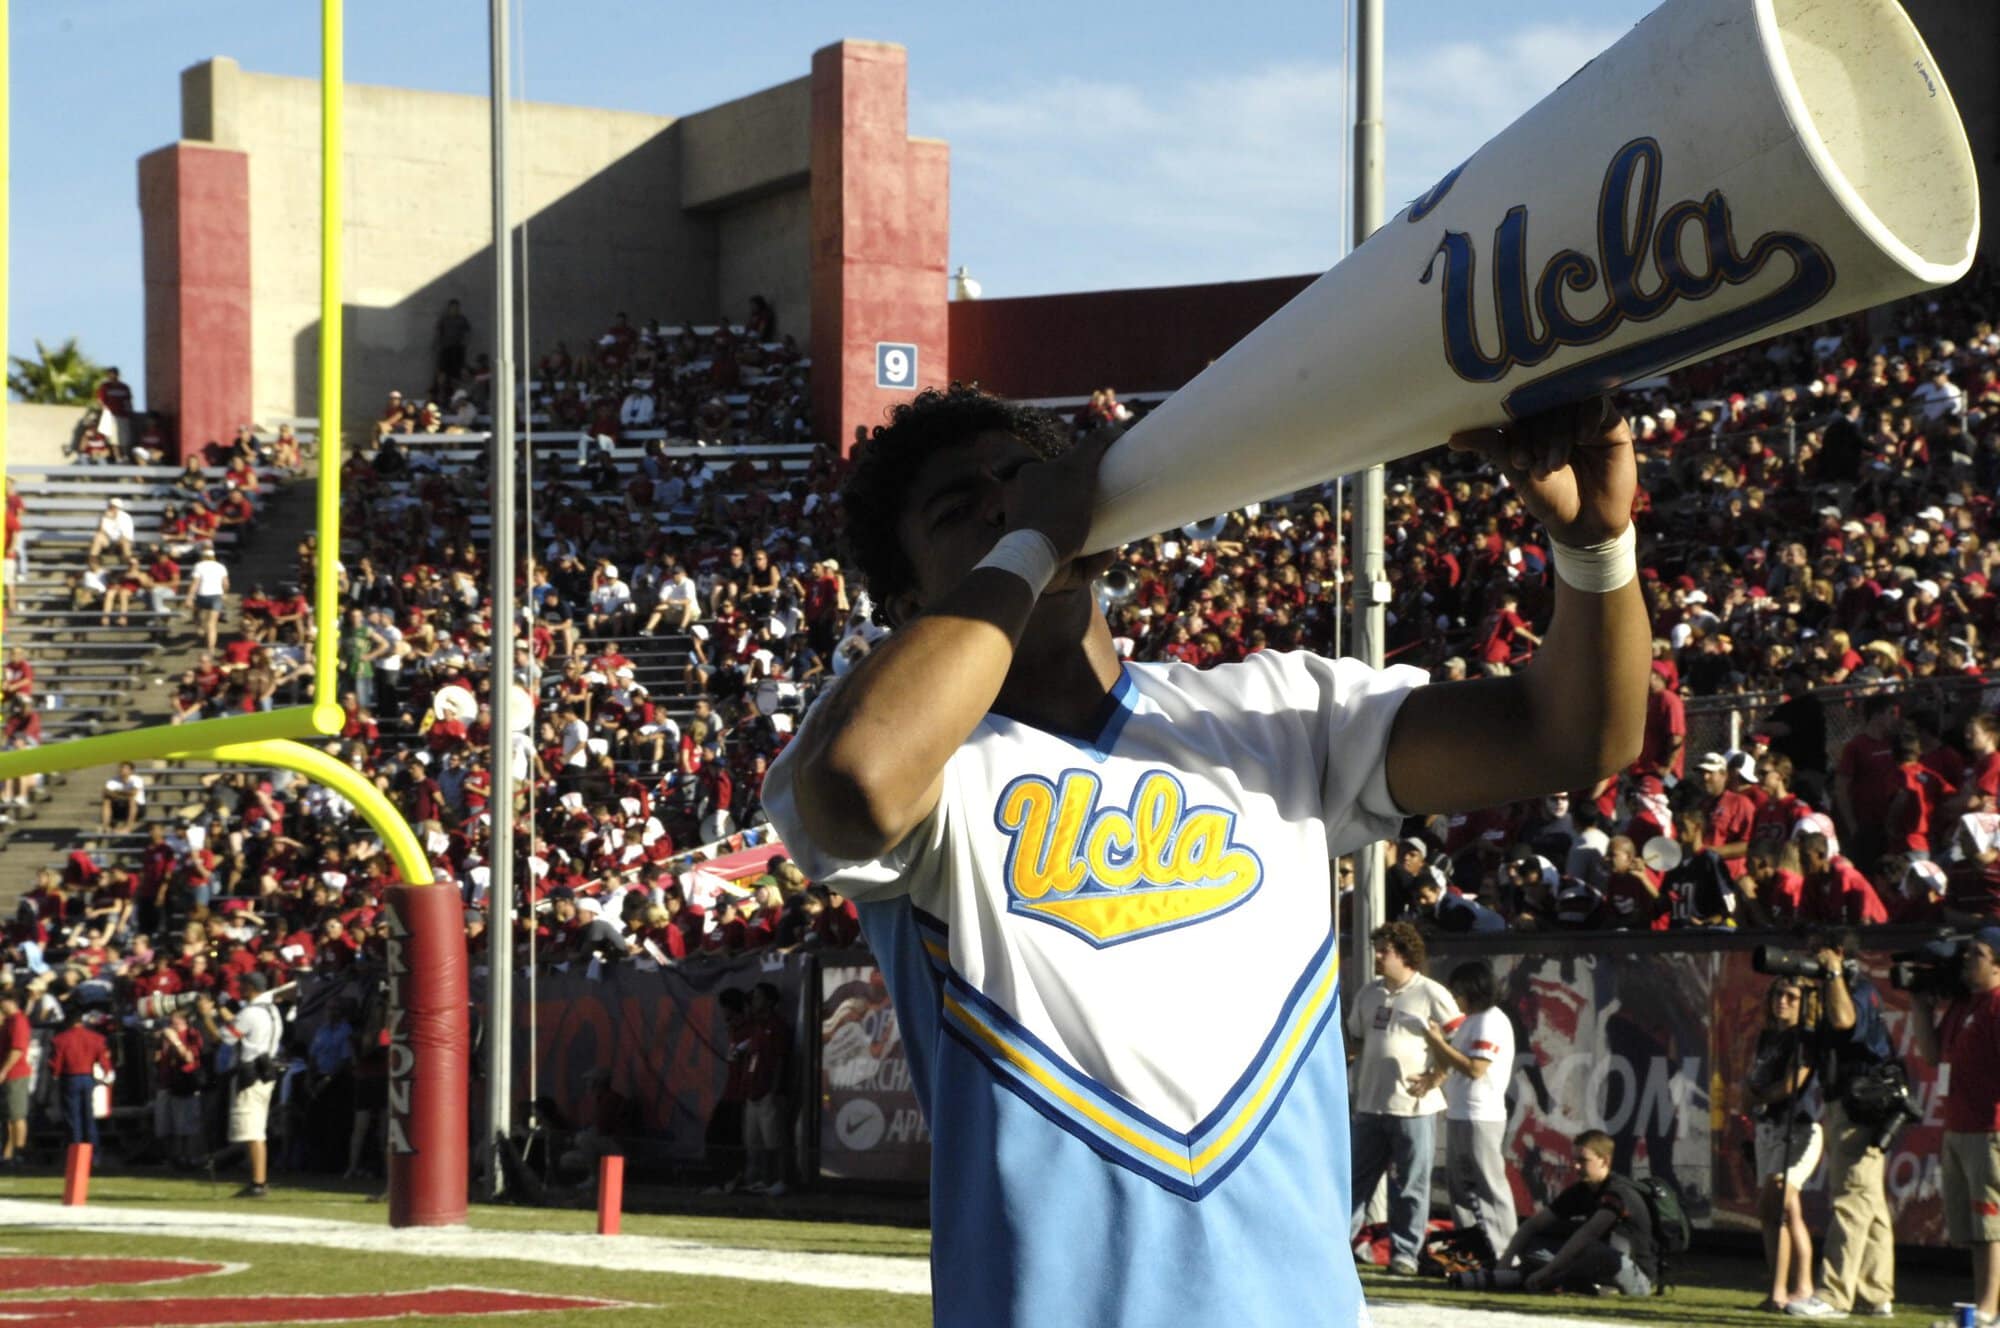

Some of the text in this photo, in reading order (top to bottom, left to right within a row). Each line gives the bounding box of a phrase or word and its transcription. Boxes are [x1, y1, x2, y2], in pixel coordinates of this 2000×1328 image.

[885, 349, 909, 383] 9
[385, 902, 416, 1154] ARIZONA
[516, 995, 717, 1128] ZONA
